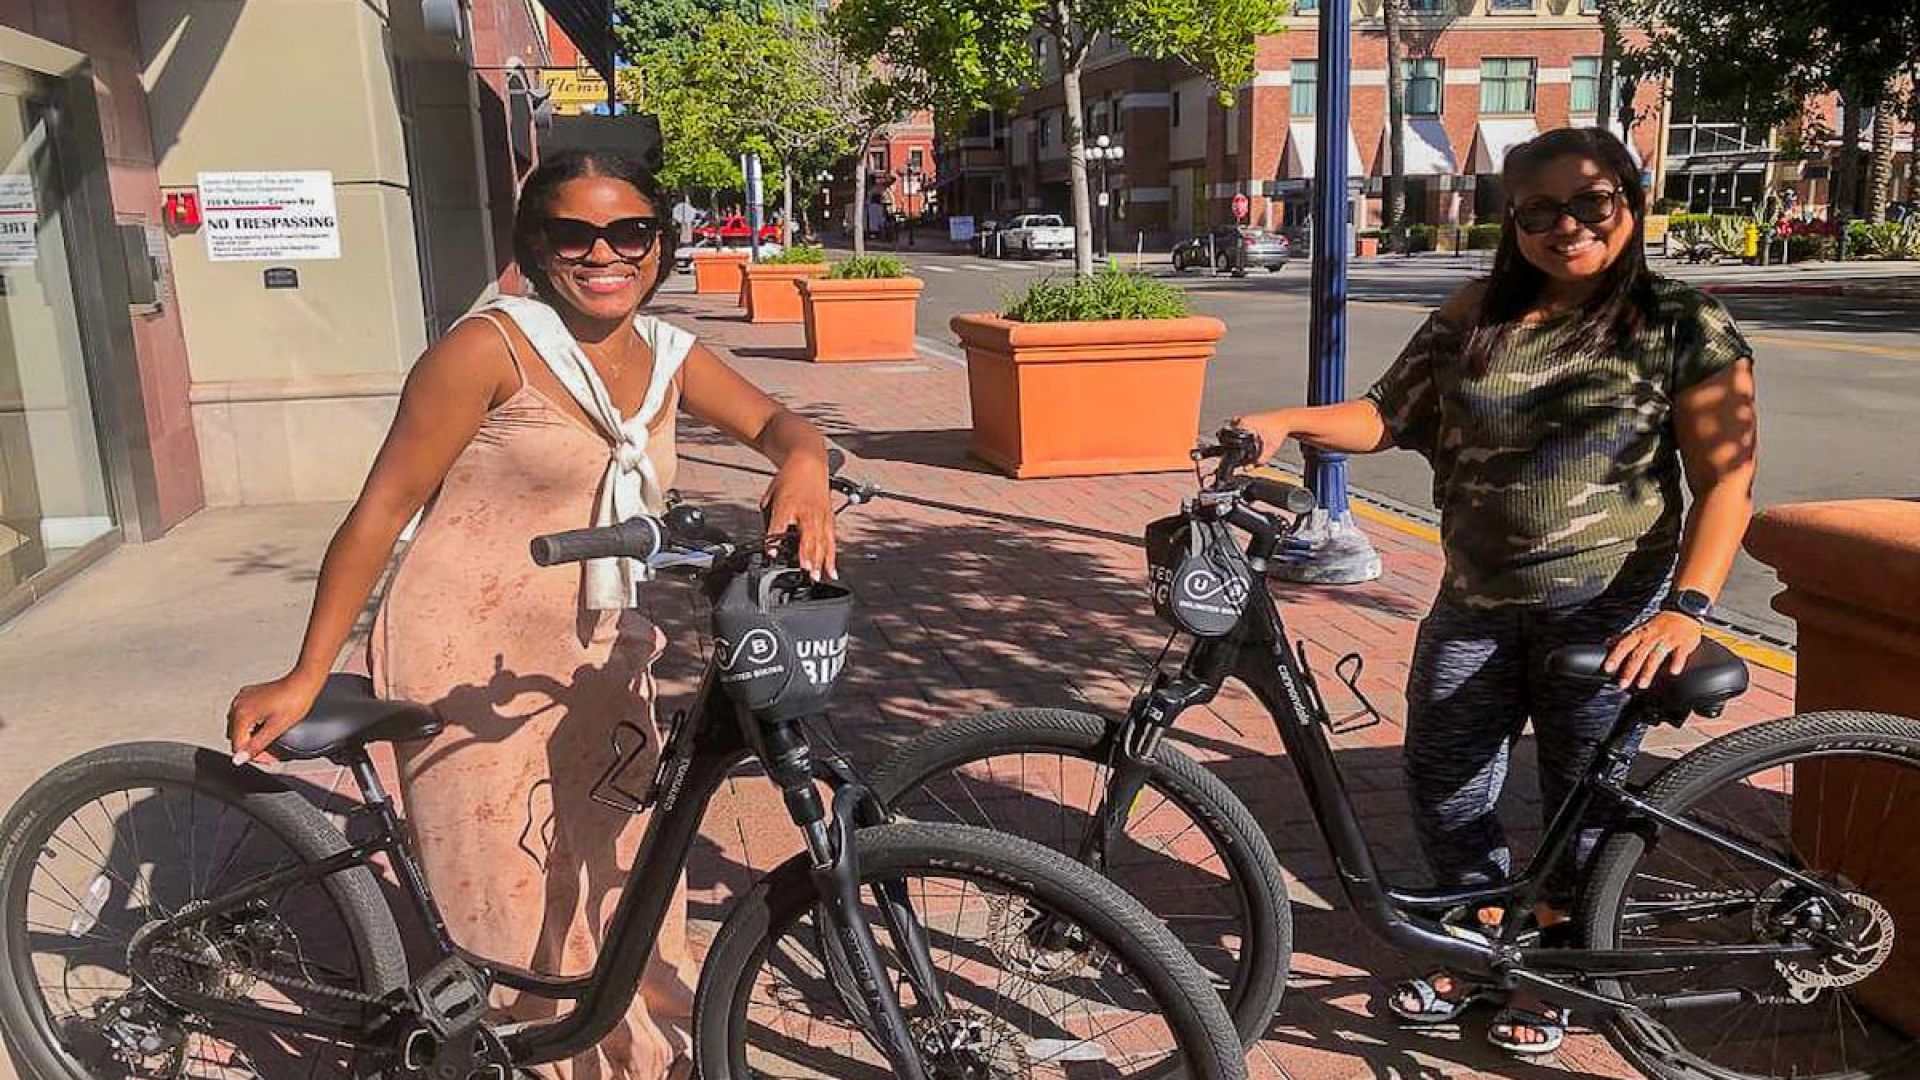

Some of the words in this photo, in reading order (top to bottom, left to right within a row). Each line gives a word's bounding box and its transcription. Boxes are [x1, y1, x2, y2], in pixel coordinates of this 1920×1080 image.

[207, 218, 229, 230] NO
[235, 216, 334, 229] TRESPASSING
[1194, 577, 1209, 591] U
[751, 638, 769, 655] B
